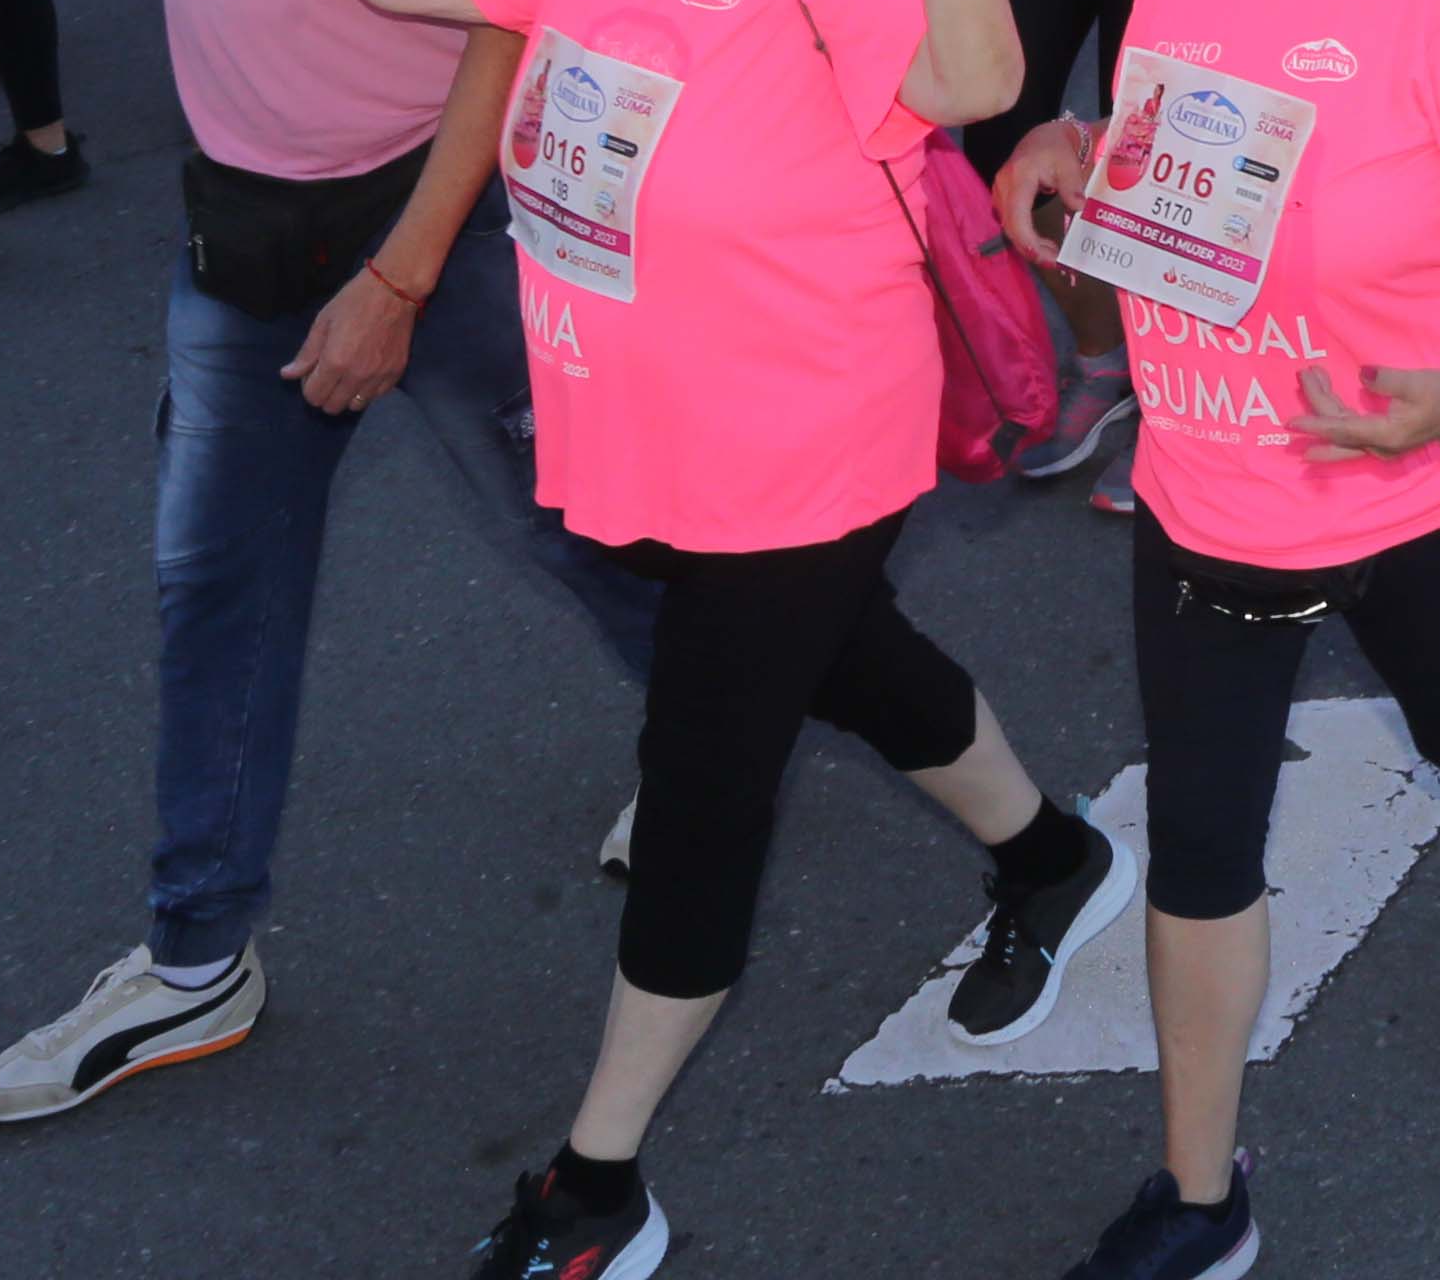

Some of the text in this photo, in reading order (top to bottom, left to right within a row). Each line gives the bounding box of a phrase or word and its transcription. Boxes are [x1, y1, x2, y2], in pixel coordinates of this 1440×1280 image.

[1288, 53, 1350, 75] ASTURIANA
[612, 95, 655, 118] SUMA
[1172, 102, 1239, 140] ASTURIANA
[1255, 120, 1295, 142] SUMA
[542, 130, 587, 177] 016
[1152, 152, 1217, 199] 016
[1151, 197, 1193, 226] 5170
[1080, 238, 1134, 269] OYSHO
[1095, 207, 1247, 273] CARRERA DE LA MUJER 2023
[567, 248, 621, 281] Santander
[1178, 272, 1240, 307] Santander
[521, 272, 583, 359] MA
[1139, 359, 1282, 427] SUMA
[1257, 433, 1292, 447] 2023
